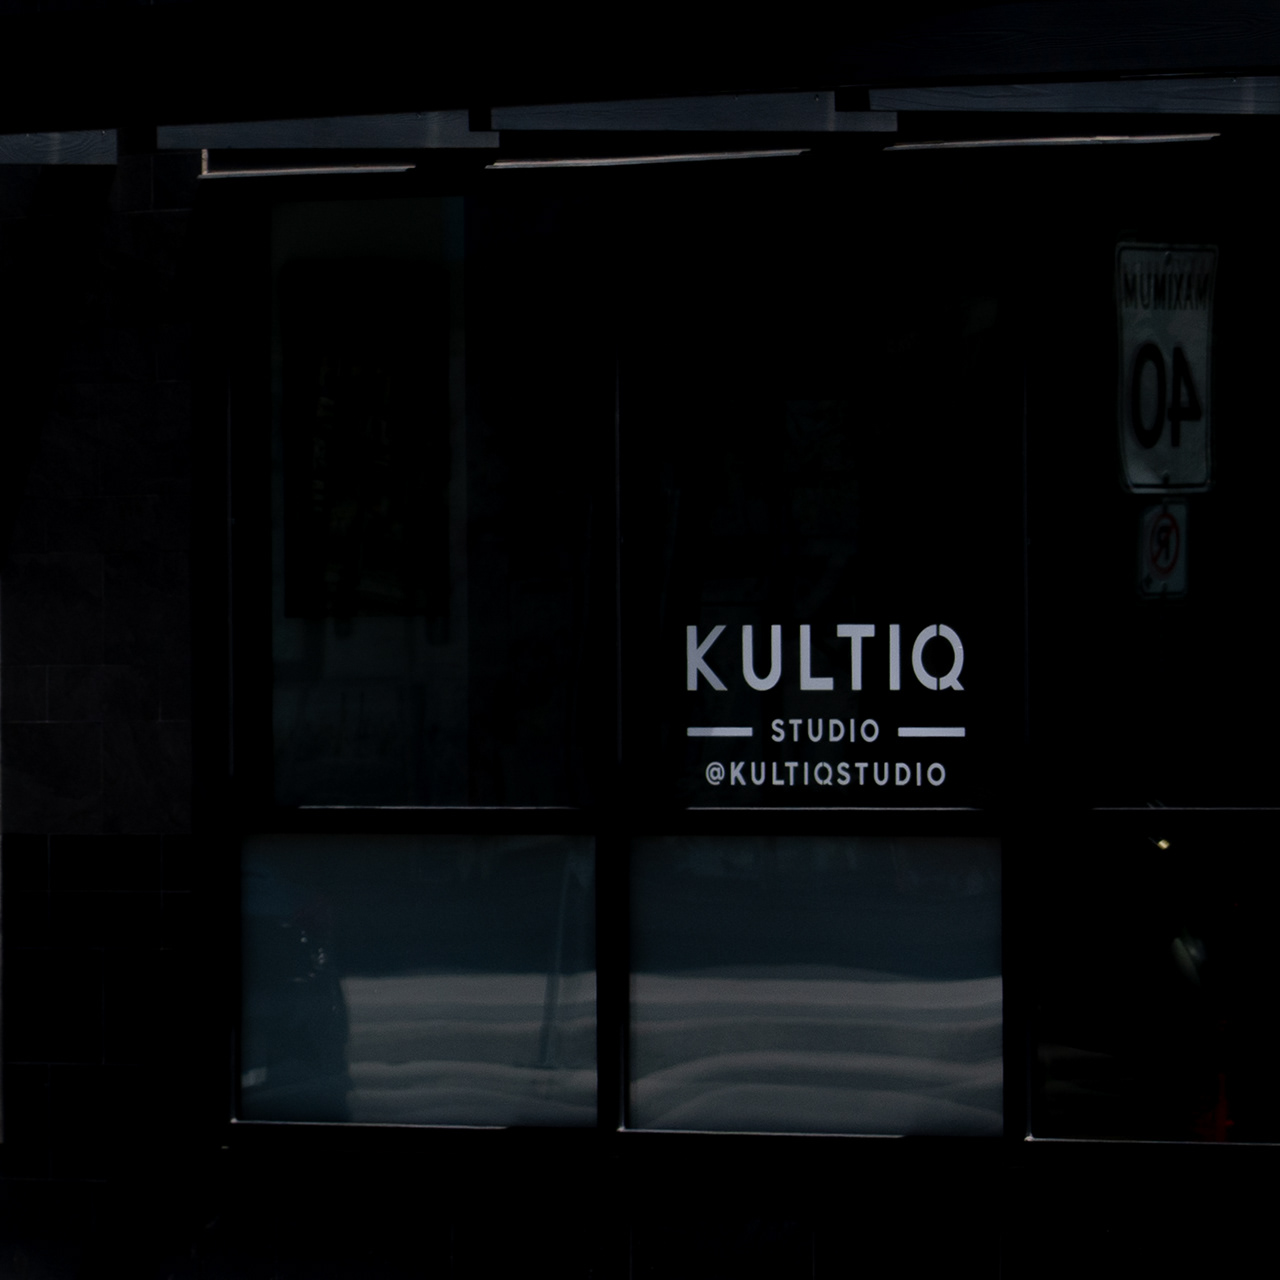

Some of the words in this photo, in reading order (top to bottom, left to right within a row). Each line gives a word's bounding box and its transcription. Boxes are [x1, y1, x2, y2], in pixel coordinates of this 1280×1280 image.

[686, 624, 965, 691] KULTIQ
[771, 718, 879, 742] STUDIO
[705, 761, 946, 786] @KULTIQSTUDIO
